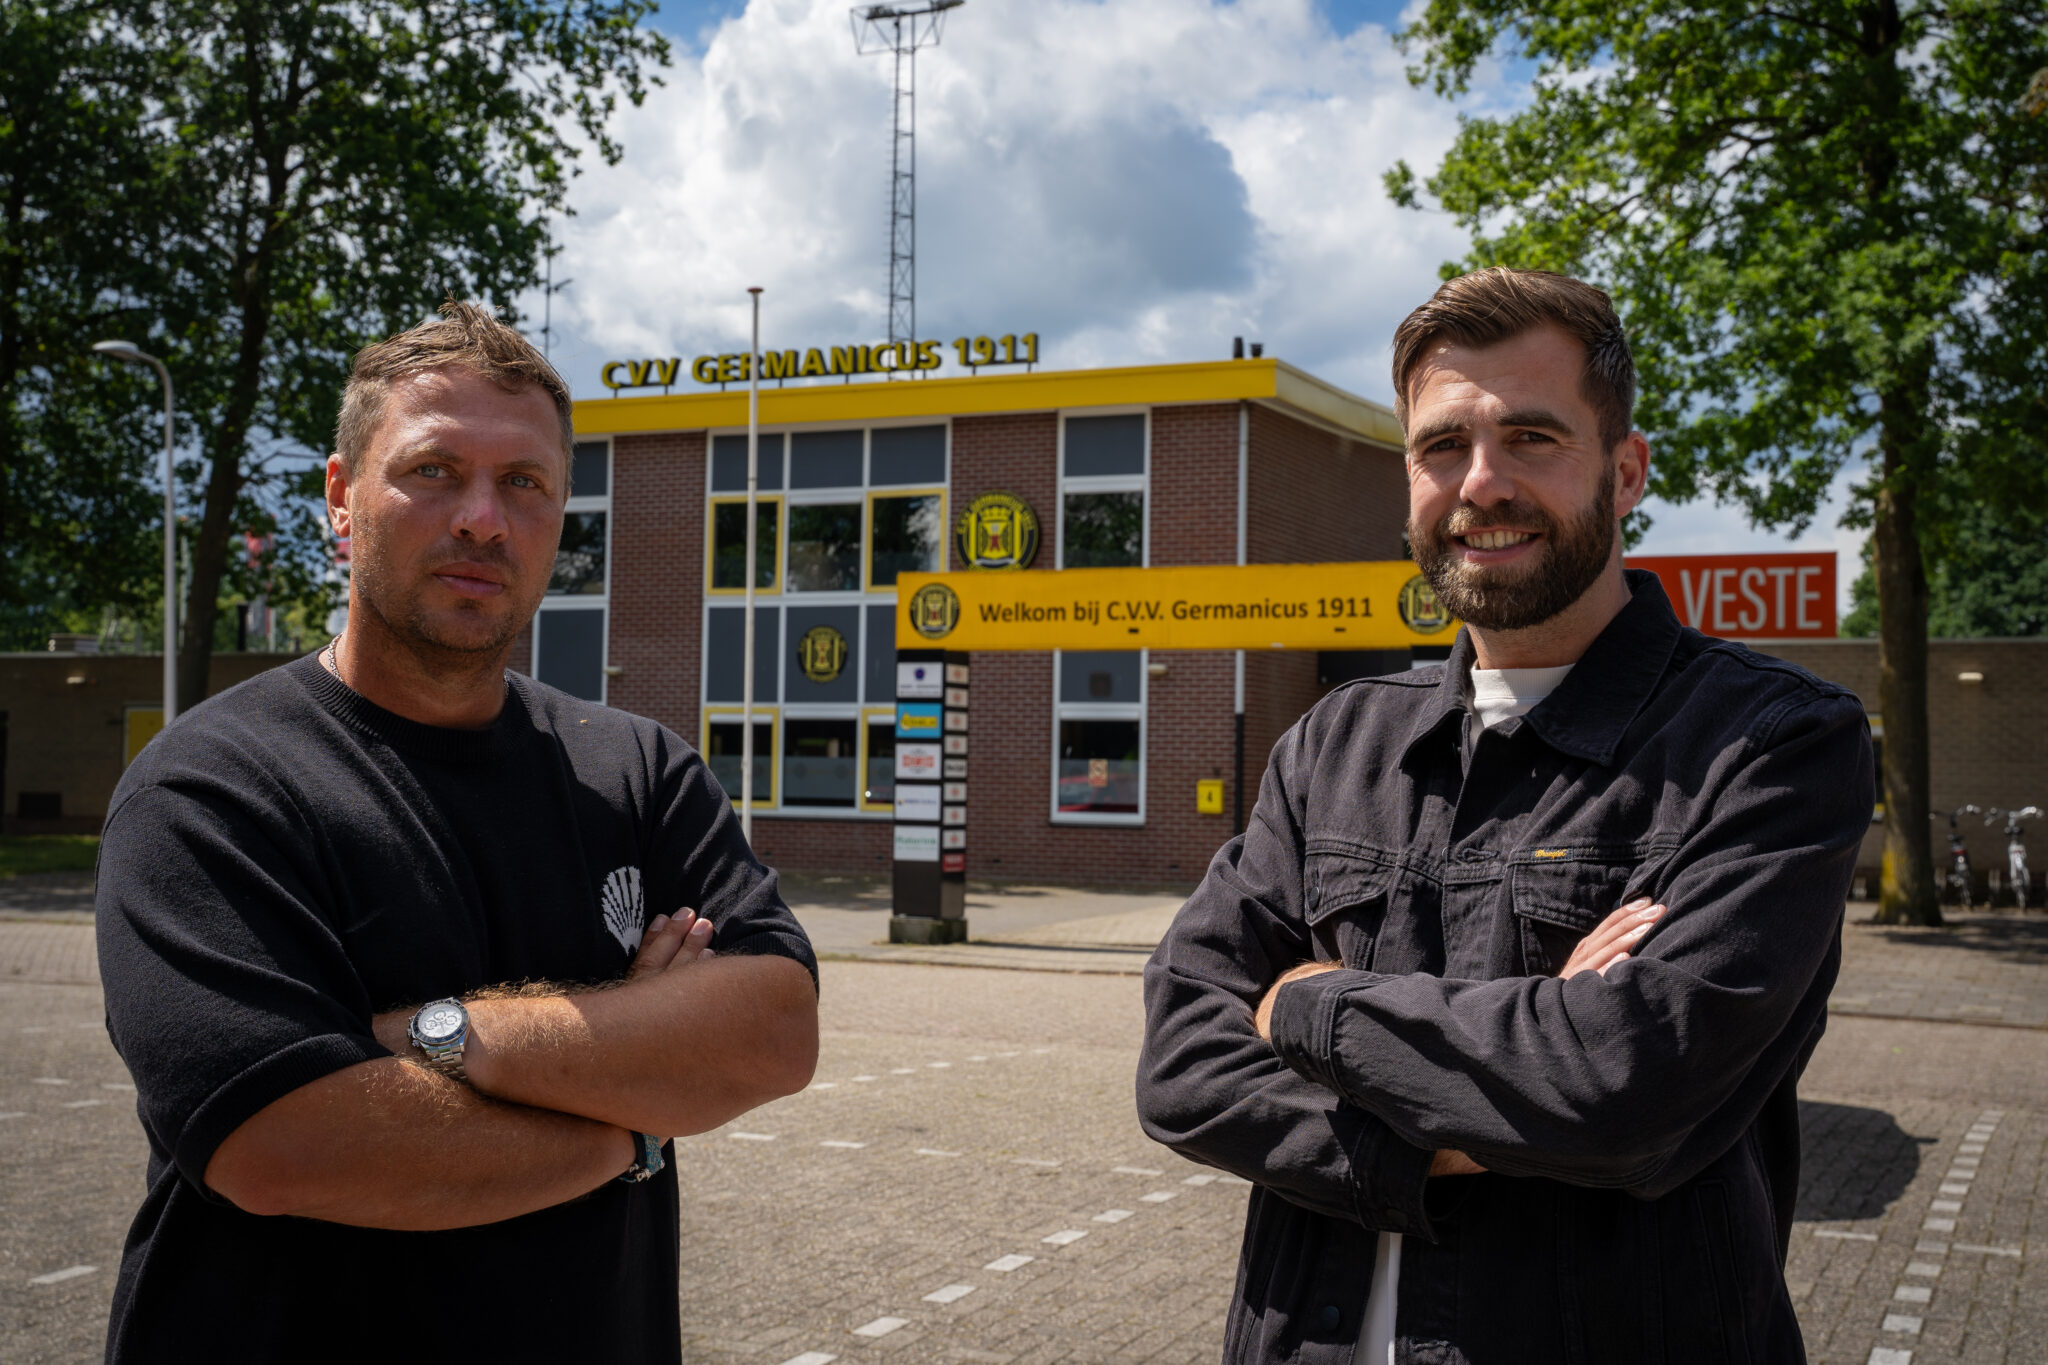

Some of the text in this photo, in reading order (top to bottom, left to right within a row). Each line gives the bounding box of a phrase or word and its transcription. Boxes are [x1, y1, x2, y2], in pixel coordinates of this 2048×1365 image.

[601, 332, 1038, 389] CVV GERMANICUS 1911
[979, 597, 1373, 625] Welkom bij C.V.V. Germanicus 1911
[1680, 566, 1822, 631] VESTE
